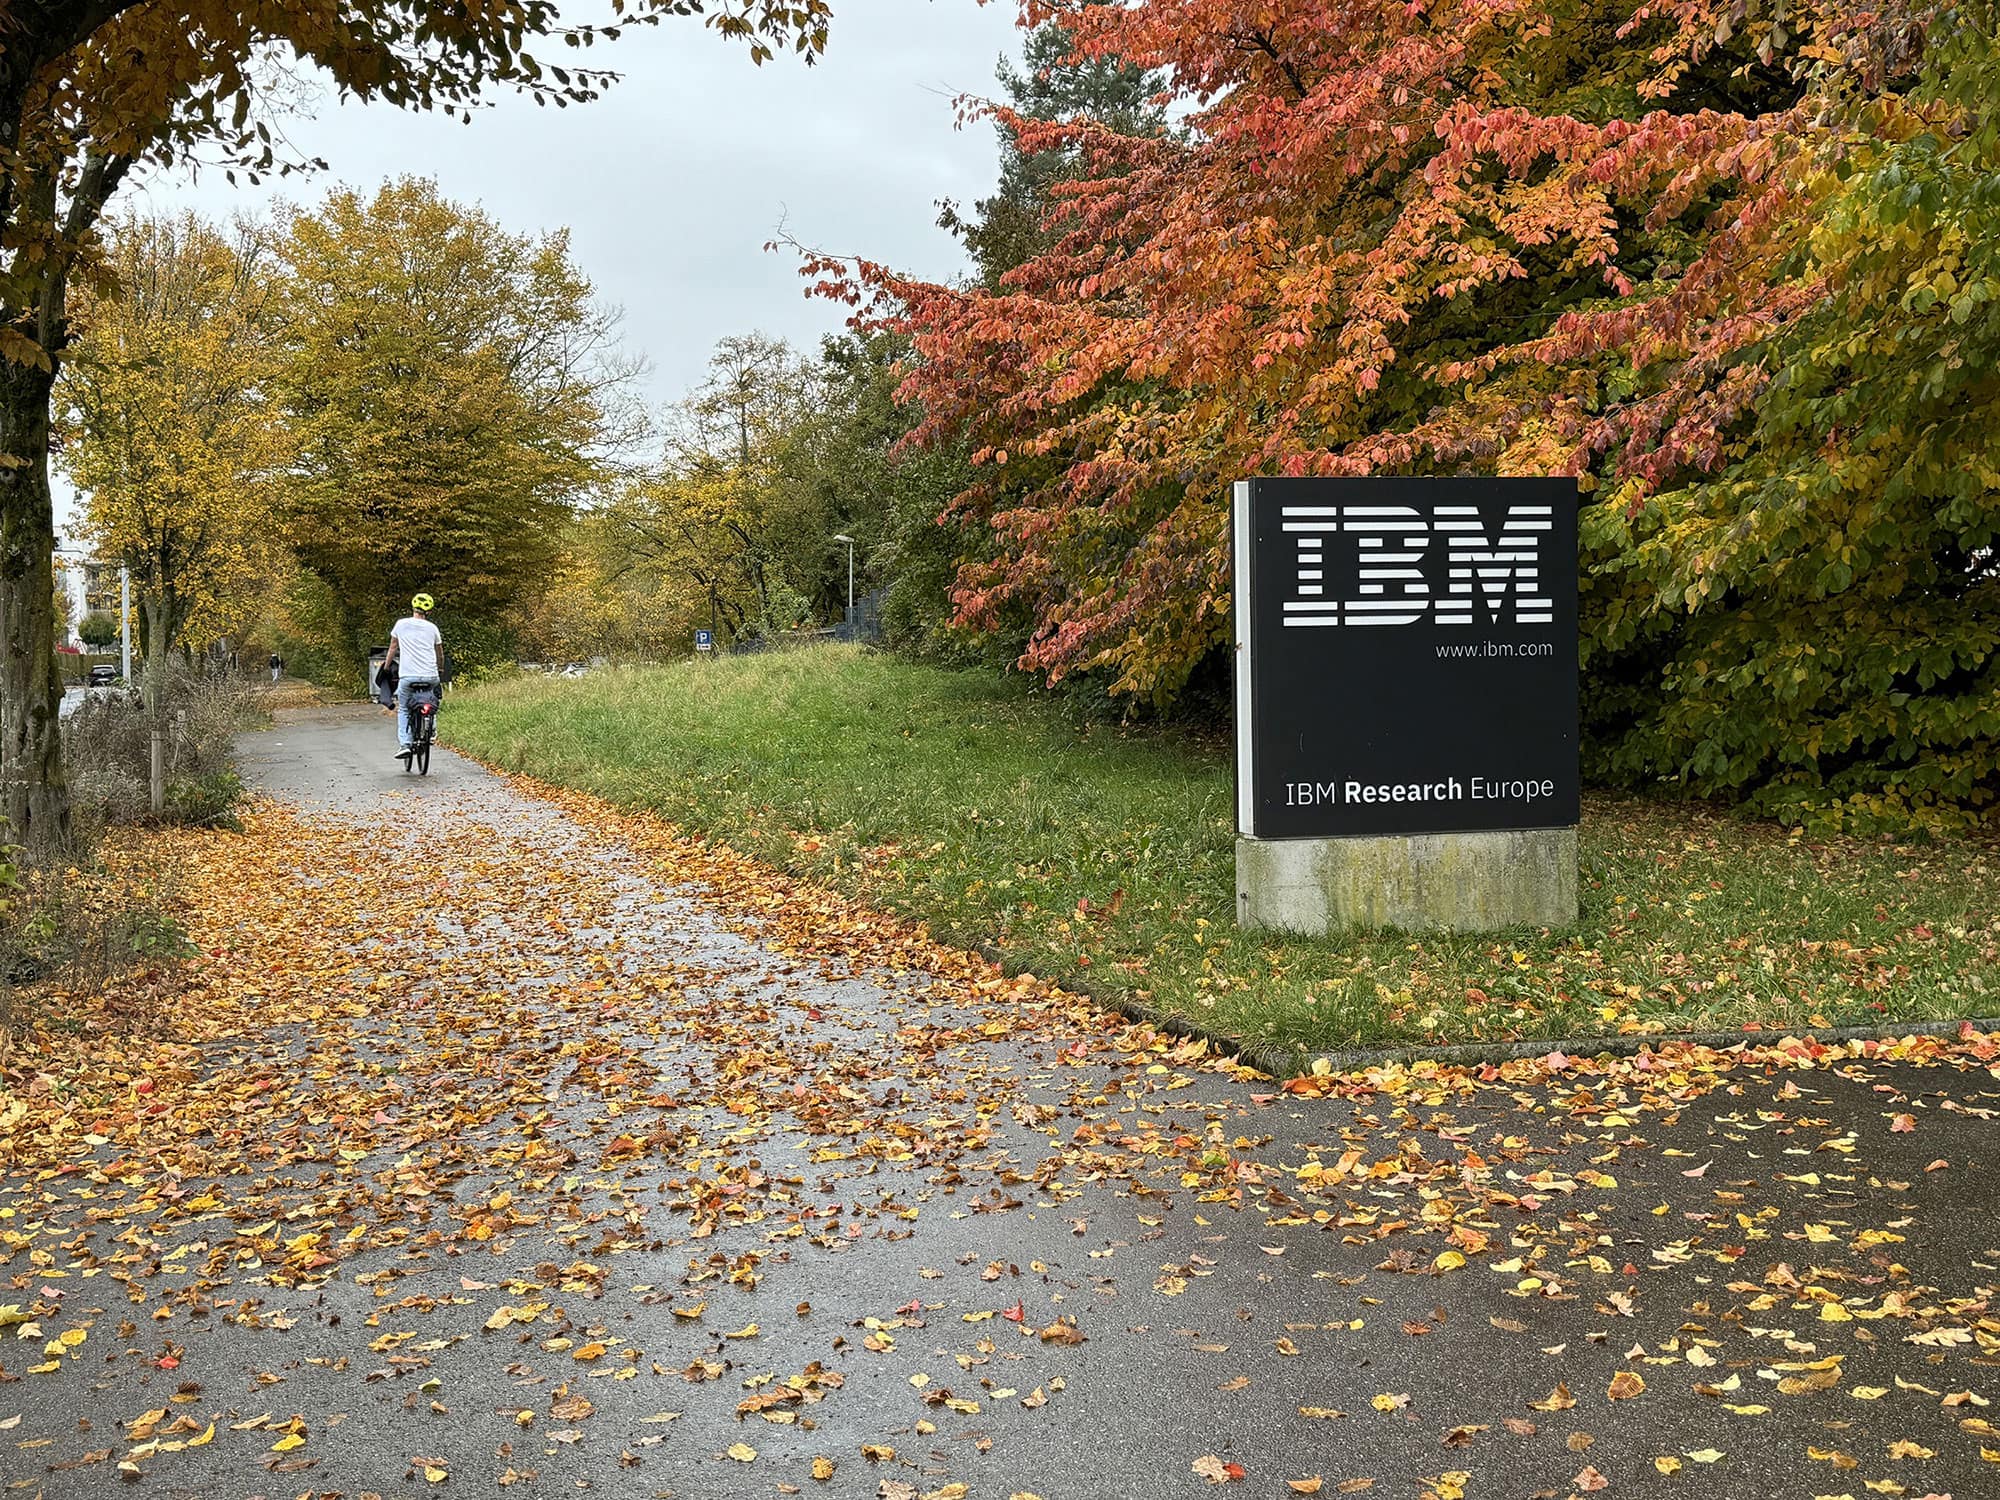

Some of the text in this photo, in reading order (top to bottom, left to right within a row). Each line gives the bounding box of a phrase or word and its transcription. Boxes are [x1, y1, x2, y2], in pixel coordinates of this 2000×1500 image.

[1281, 506, 1553, 627] IBM
[699, 632, 708, 643] P
[1435, 640, 1553, 658] www.ibm.com
[1285, 775, 1554, 806] IBM Research Europe
